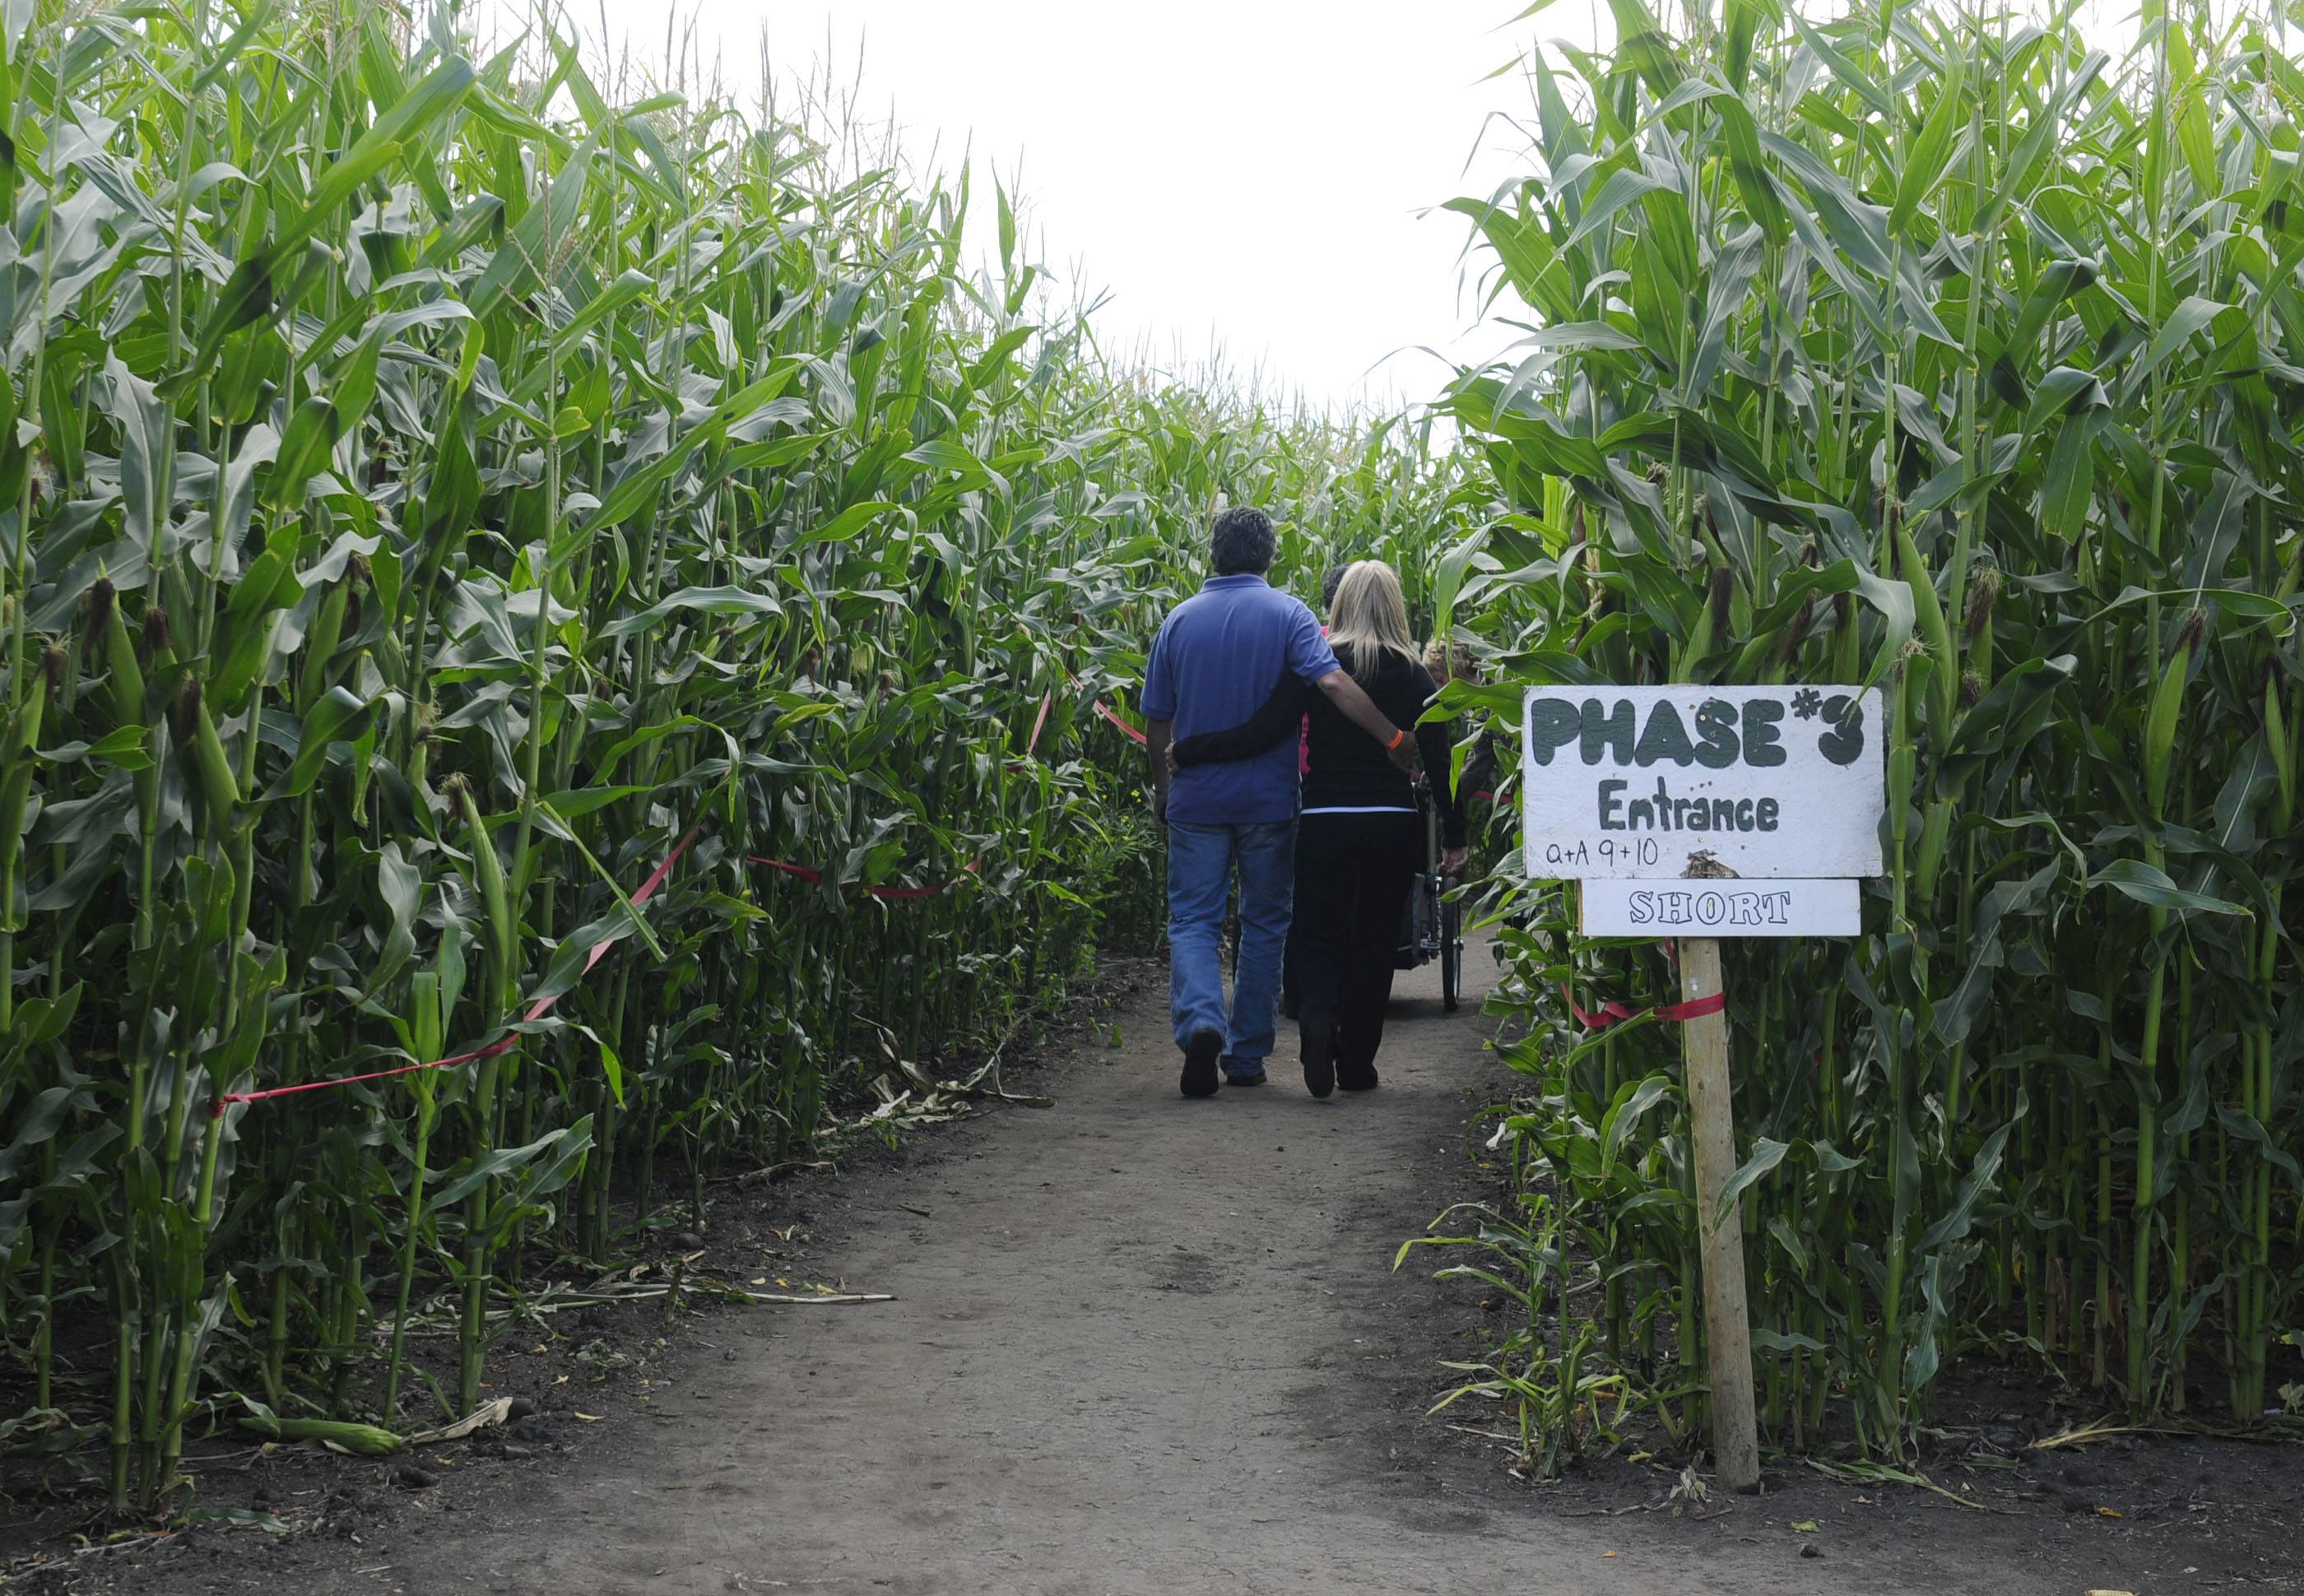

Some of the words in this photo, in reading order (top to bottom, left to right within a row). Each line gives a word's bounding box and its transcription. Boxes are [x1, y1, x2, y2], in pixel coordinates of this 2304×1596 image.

[1531, 698, 1787, 768] PHASE
[1790, 688, 1864, 765] #3
[1598, 776, 1780, 832] Entrance
[1629, 891, 1791, 926] SHORT
